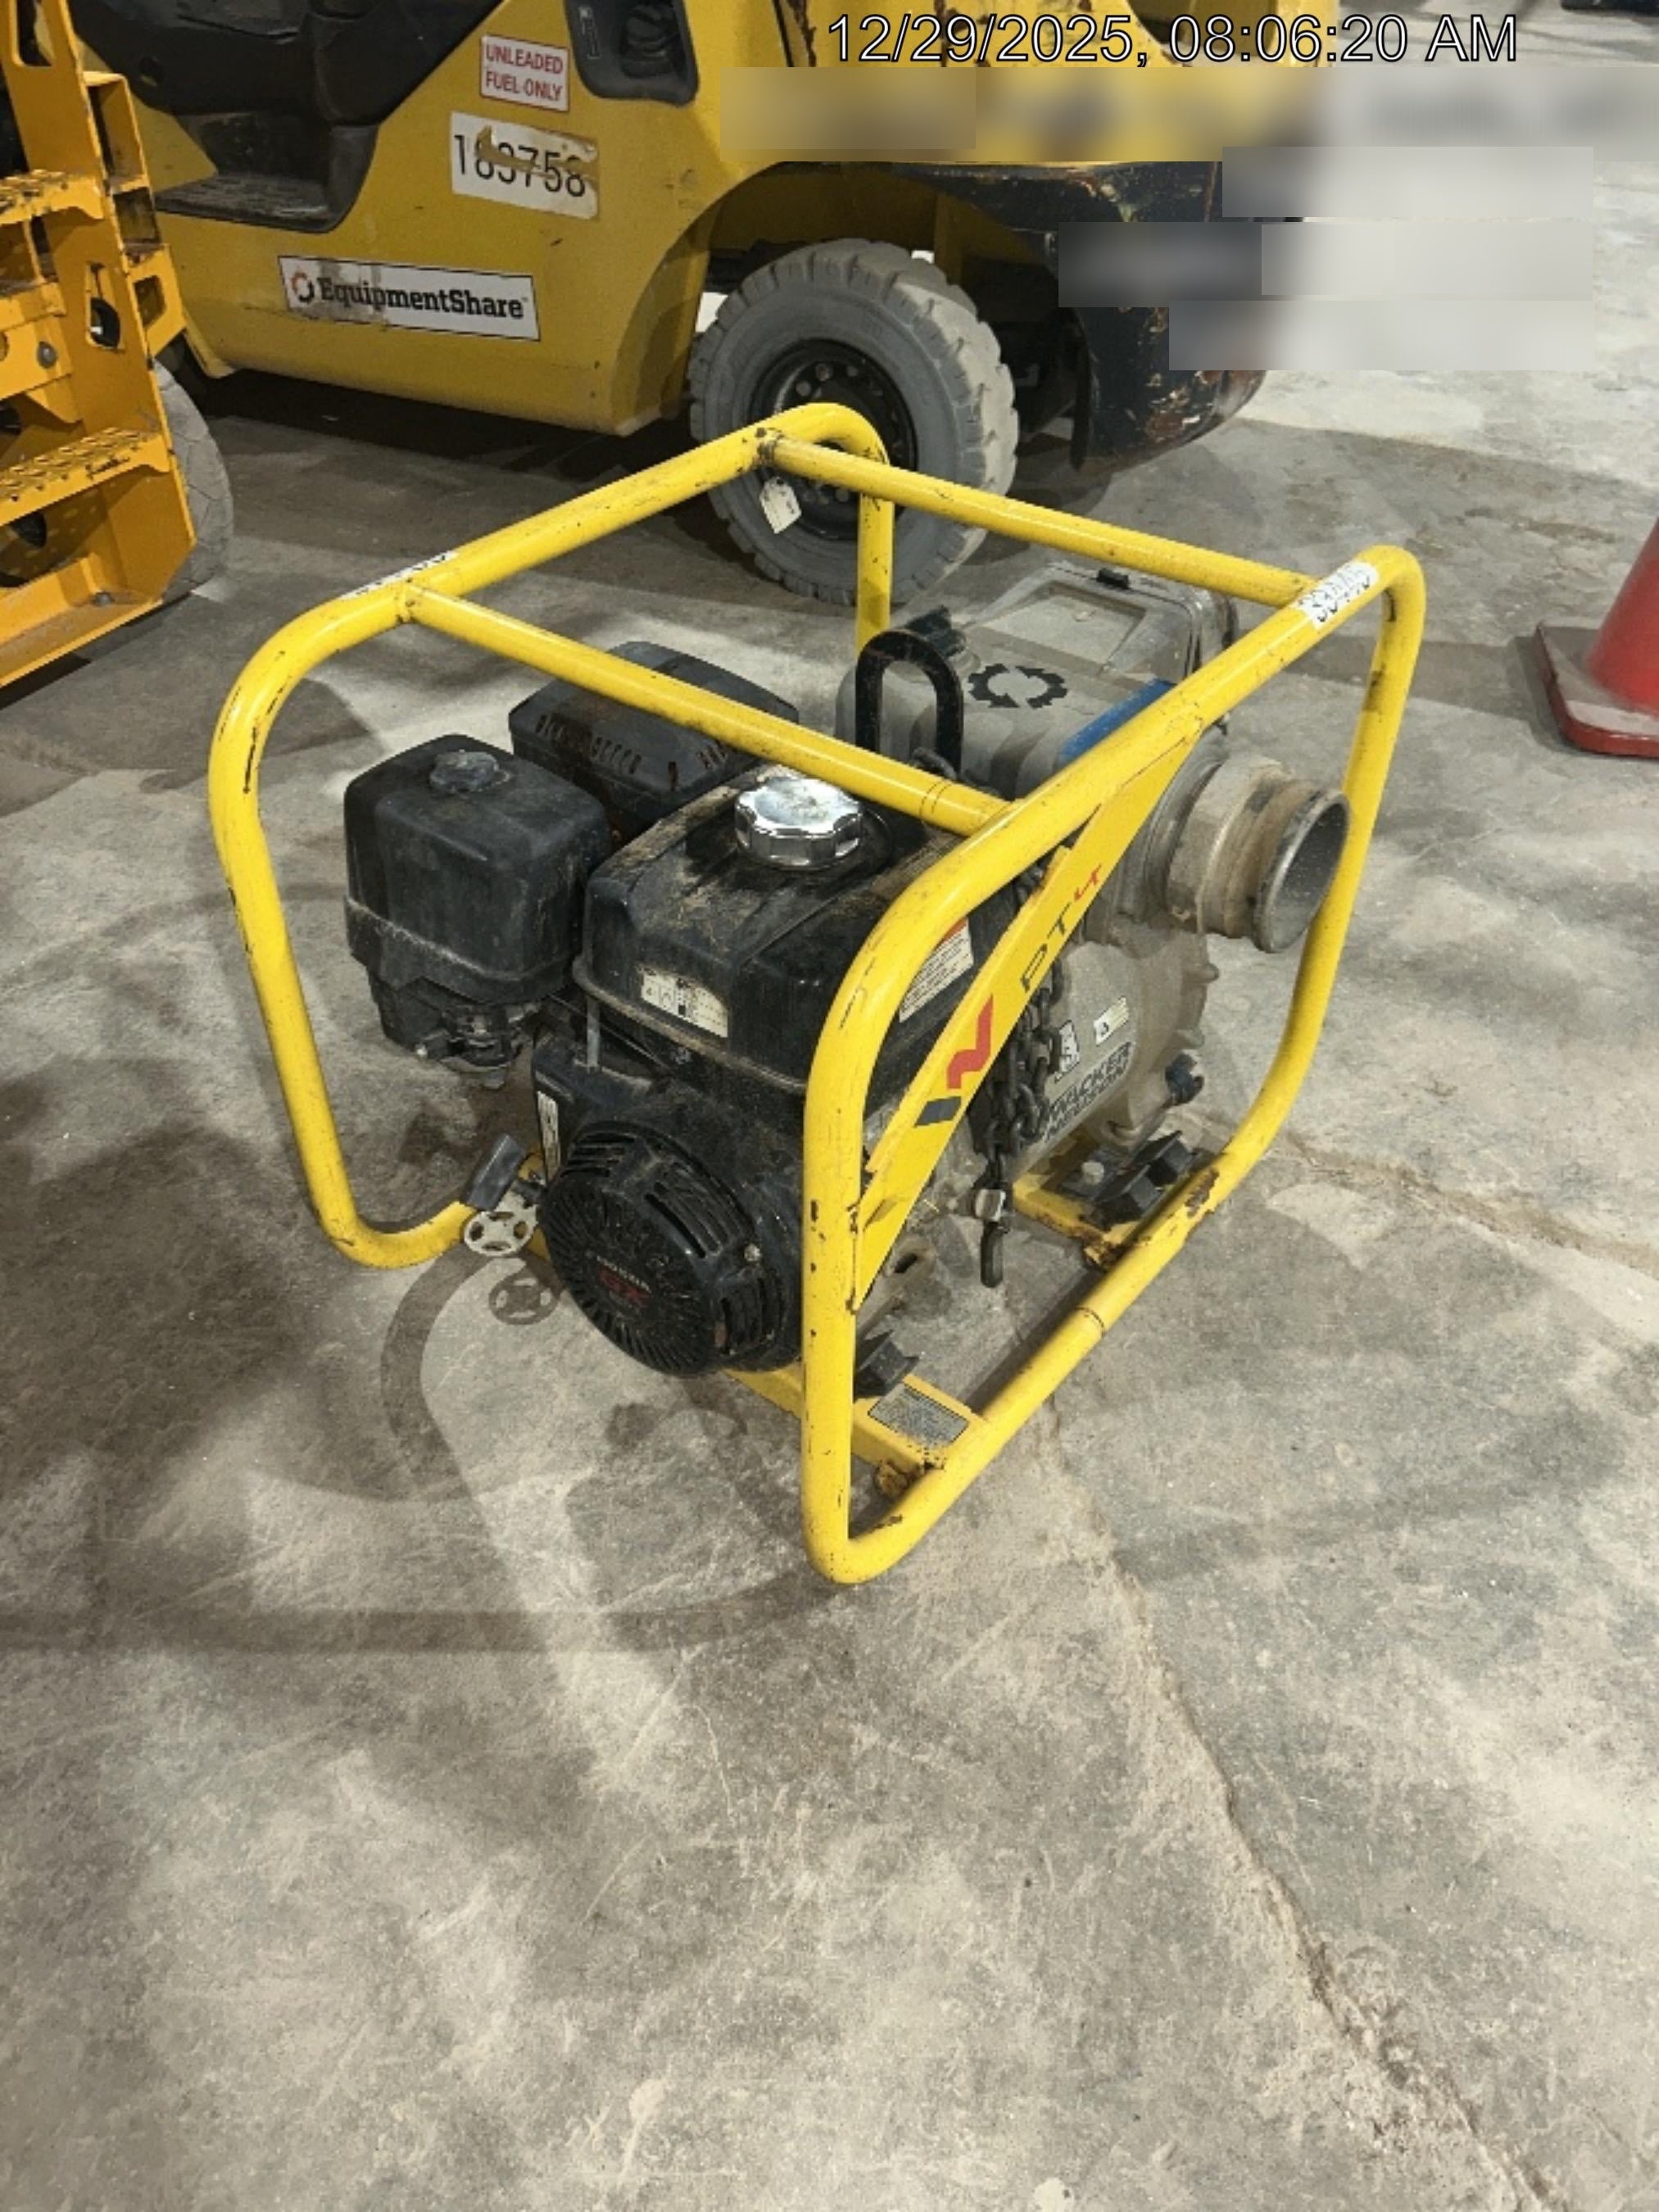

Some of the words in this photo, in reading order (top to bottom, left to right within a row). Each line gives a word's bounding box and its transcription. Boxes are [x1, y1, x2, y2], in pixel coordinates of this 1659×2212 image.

[486, 44, 564, 75] UNLEADED
[486, 70, 519, 93] FUEL
[524, 78, 563, 102] ONLY
[317, 277, 524, 320] EquipmentShare
